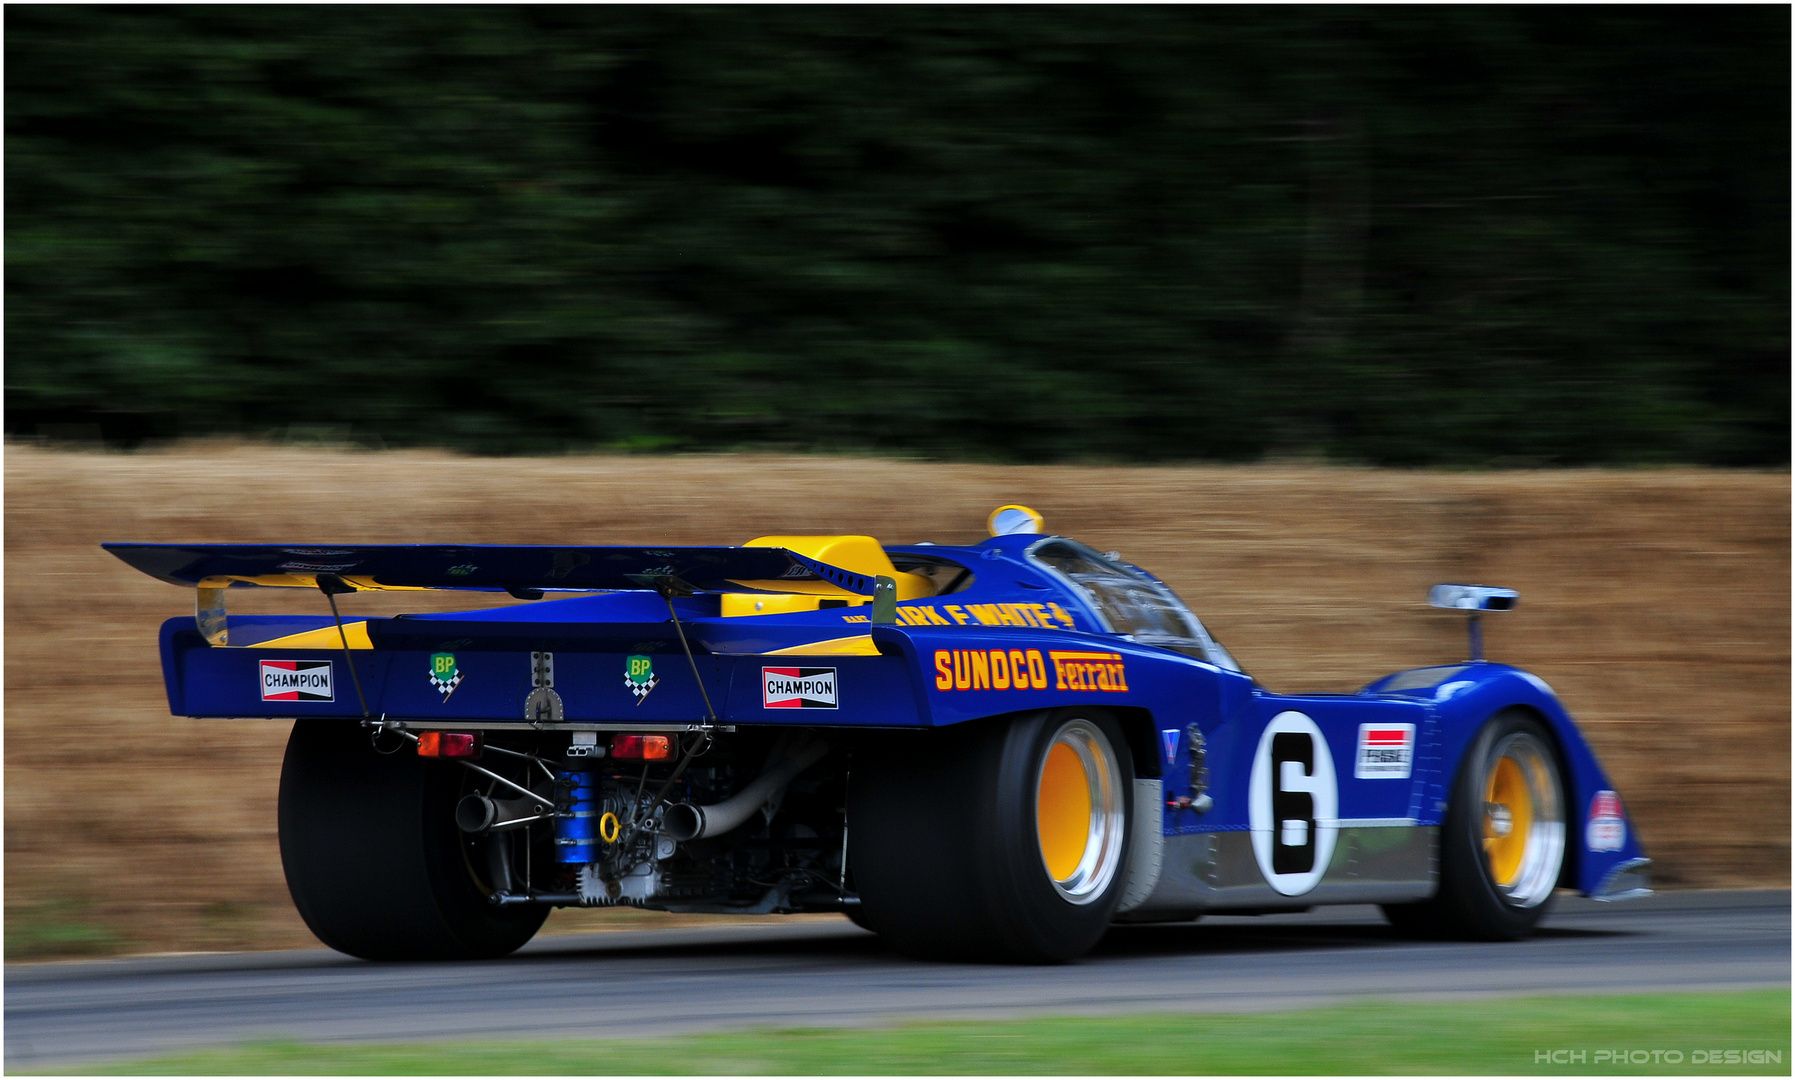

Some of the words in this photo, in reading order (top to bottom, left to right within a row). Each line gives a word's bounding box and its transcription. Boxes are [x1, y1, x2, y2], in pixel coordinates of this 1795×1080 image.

[963, 603, 1059, 629] WHITE
[435, 656, 455, 673] BP
[631, 658, 651, 676] BP
[934, 648, 1048, 692] SUNOCO
[1049, 650, 1129, 692] Ferrari
[265, 673, 329, 688] CHAMPION
[767, 680, 833, 695] CHAMPION
[1271, 732, 1317, 875] 6
